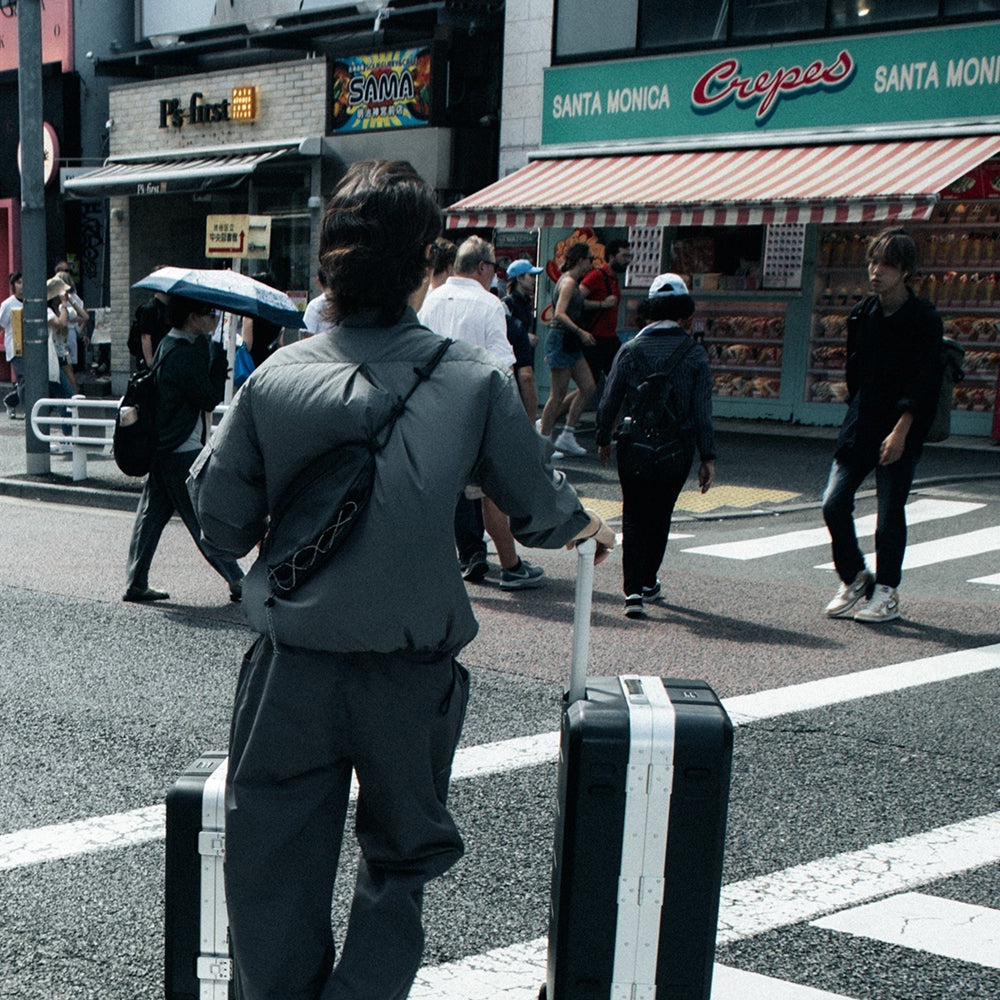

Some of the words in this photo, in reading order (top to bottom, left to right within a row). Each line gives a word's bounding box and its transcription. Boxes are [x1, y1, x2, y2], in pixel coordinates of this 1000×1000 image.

[349, 71, 414, 106] SAMA
[692, 50, 853, 118] Crepes
[874, 60, 940, 94] SANTA
[552, 90, 602, 119] SANTA
[607, 84, 670, 114] MONICA
